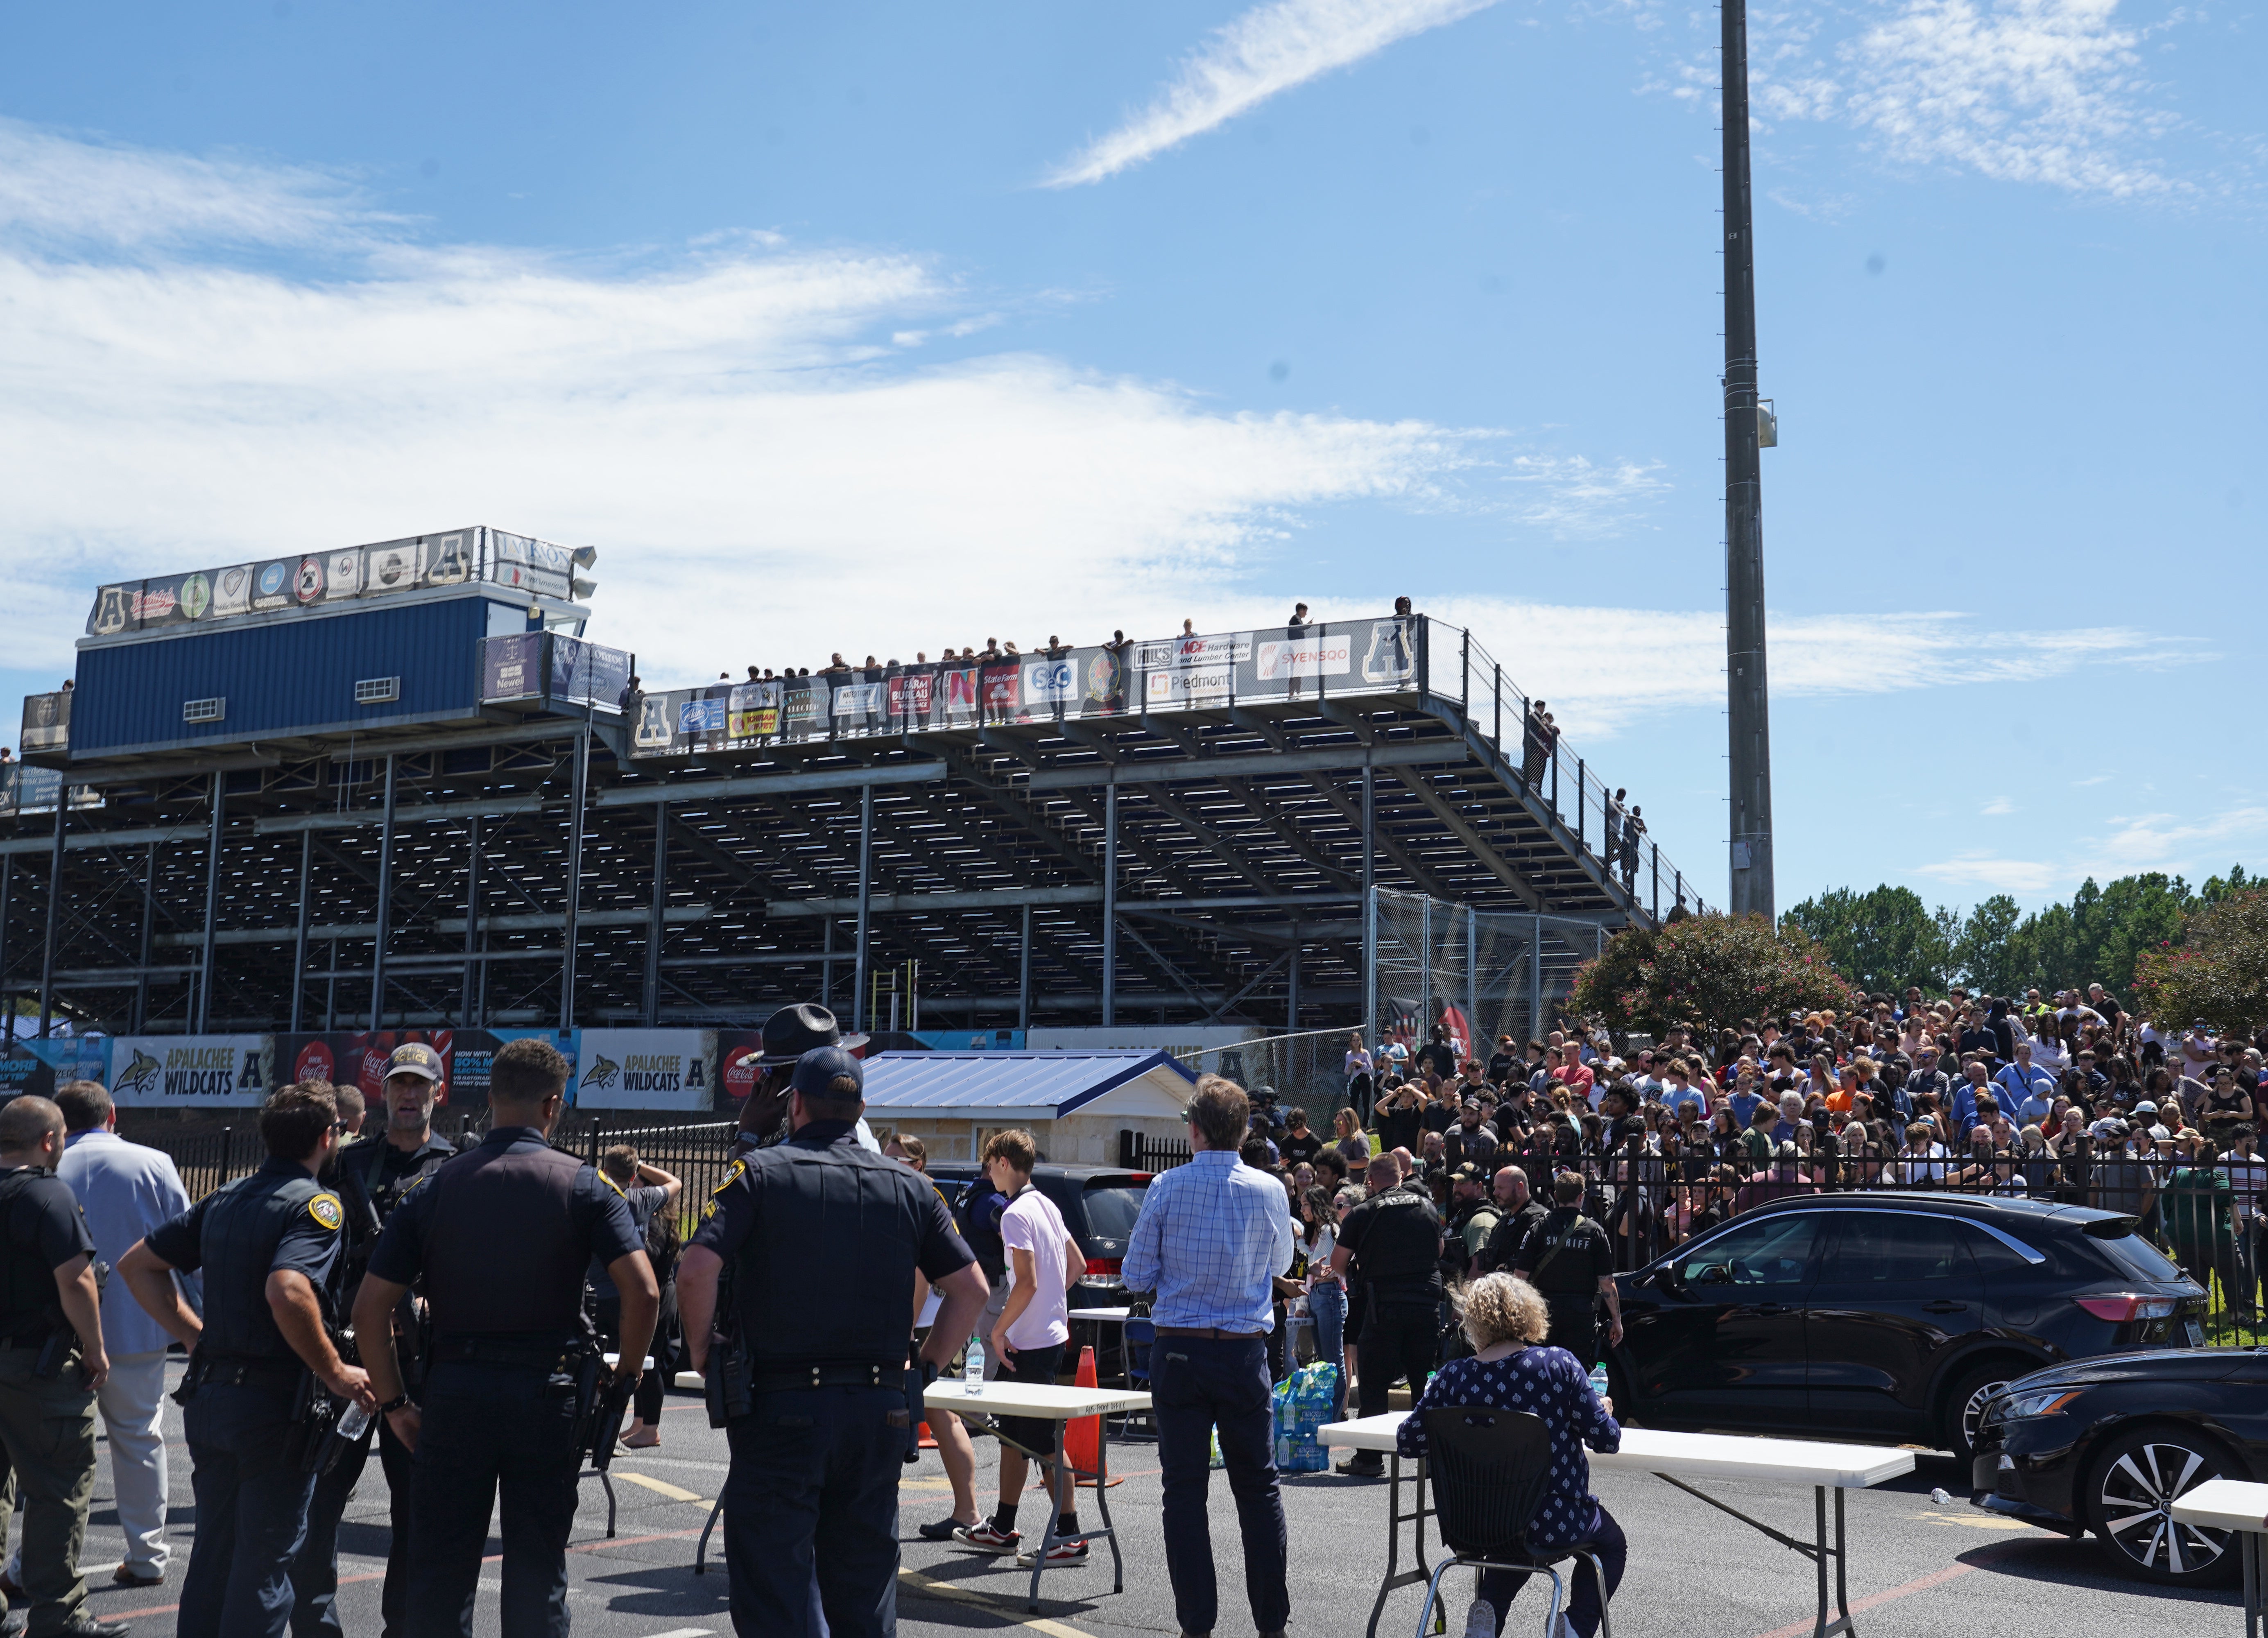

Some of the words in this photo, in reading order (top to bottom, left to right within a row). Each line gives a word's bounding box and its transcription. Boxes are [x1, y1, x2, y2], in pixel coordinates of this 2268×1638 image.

[1180, 640, 1208, 654] ACE
[1208, 642, 1249, 652] Hardware
[1363, 620, 1414, 683] A
[1194, 653, 1222, 661] Lumber
[497, 676, 525, 689] Newell
[903, 679, 928, 690] FARM
[984, 676, 1002, 684] State
[1001, 674, 1018, 682] Farm
[1172, 674, 1231, 690] Piedmont
[892, 689, 928, 701] BUREAU
[898, 701, 928, 710] INSURANCE
[635, 696, 672, 747] A
[747, 714, 776, 724] ICHIBAN
[165, 1048, 235, 1070] APALACHEE
[393, 1053, 428, 1065] POLICE
[454, 1057, 481, 1067] 50%
[624, 1054, 681, 1072] APALACHEE
[727, 1066, 756, 1079] Coca-Cola
[165, 1070, 232, 1095] WILDCATS
[624, 1072, 680, 1091] WILDCATS
[1546, 1236, 1589, 1249] SHRIFF
[1302, 1410, 1326, 1419] niagara
